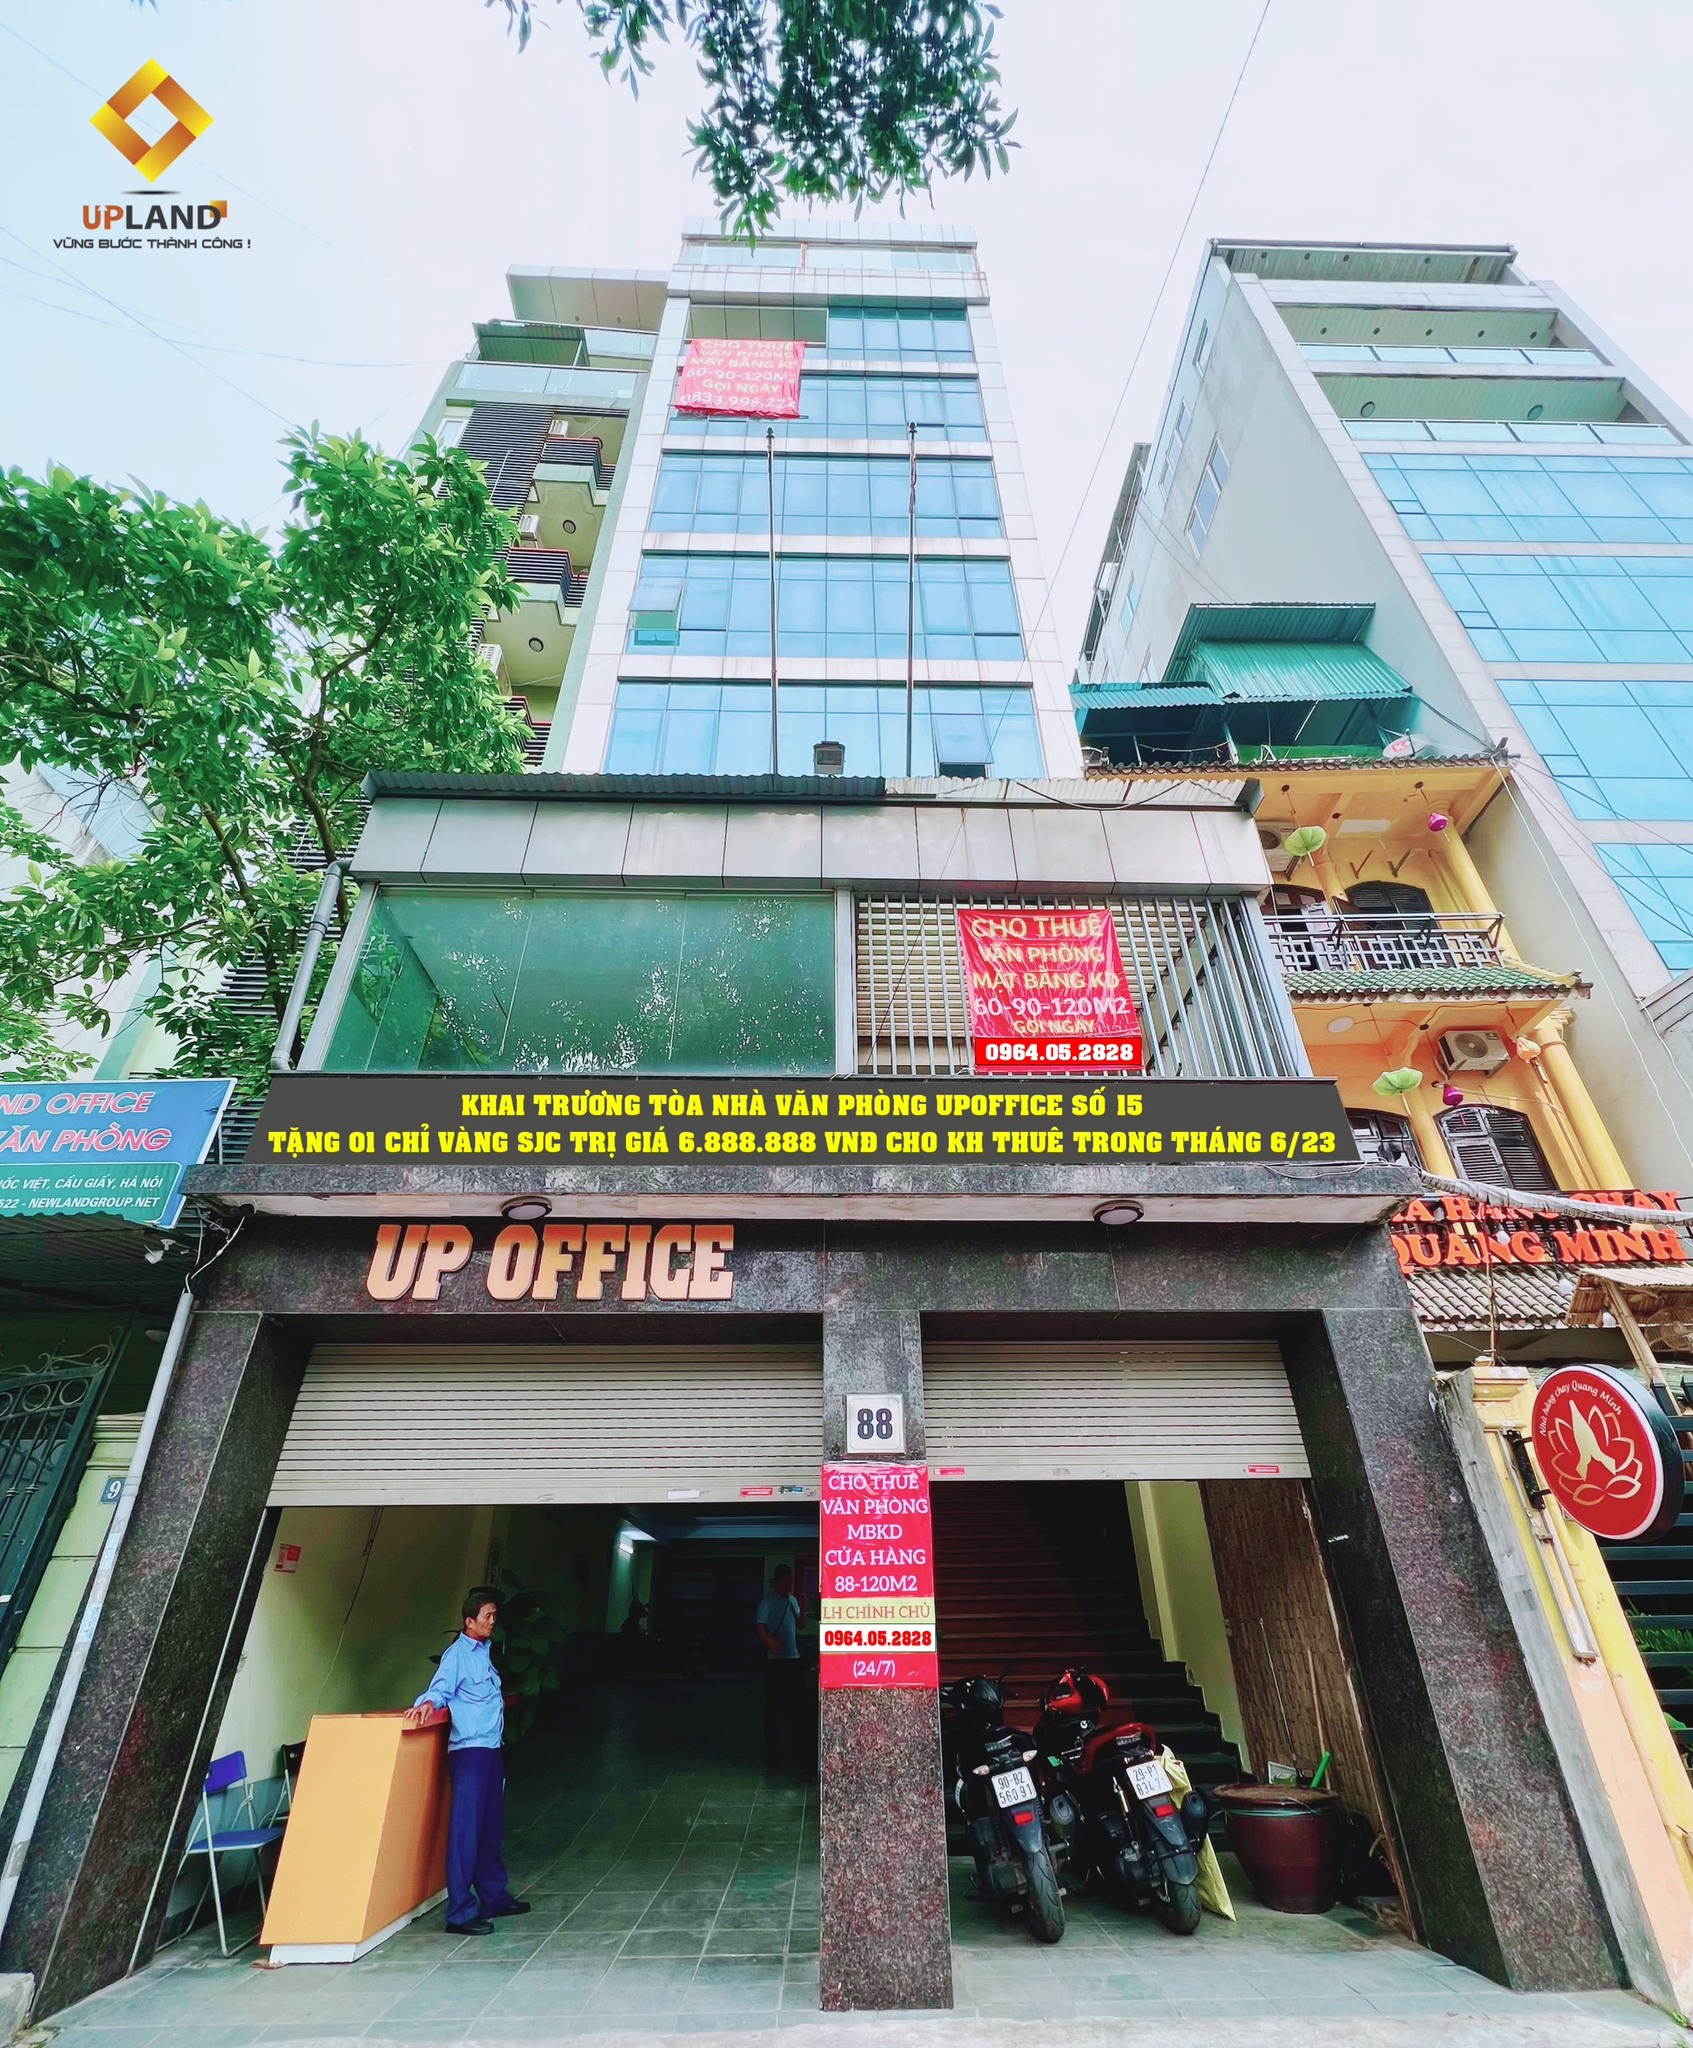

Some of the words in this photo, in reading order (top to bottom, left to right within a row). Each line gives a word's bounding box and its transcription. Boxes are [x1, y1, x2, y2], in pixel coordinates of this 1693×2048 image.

[701, 340, 741, 349] CHO
[736, 382, 781, 394] NGAY
[971, 917, 1028, 938] CHO
[1032, 912, 1104, 938] THUÊ
[979, 942, 1024, 963] VĂN
[1027, 942, 1105, 963] PHÒNG
[972, 969, 1018, 994] MẶT
[1023, 965, 1086, 989] BẰNG
[1090, 972, 1121, 989] KD
[973, 996, 1131, 1016] 60-90-120M2
[1013, 1019, 1046, 1036] GỌI
[1049, 1019, 1096, 1034] NGAY
[985, 1043, 1134, 1062] 0964.05.2828
[46, 1091, 156, 1114] OFFICE
[462, 1094, 525, 1116] KHAI
[533, 1089, 641, 1116] TRƯƠNG
[649, 1089, 703, 1116] TÒA
[712, 1089, 767, 1116] NHÀ
[775, 1089, 829, 1116] VĂN
[838, 1089, 927, 1116] PHÒNG
[936, 1094, 1063, 1116] UPOFFICE
[1071, 1086, 1107, 1116] SỐ
[1117, 1094, 1143, 1116] 15
[0, 1124, 52, 1153] ĂN
[51, 1121, 173, 1152] PHÒNG
[268, 1127, 340, 1158] TẶNG
[385, 1122, 431, 1153] CHỈ
[438, 1126, 509, 1153] VÀNG
[517, 1131, 561, 1153] SJC
[570, 1131, 617, 1159] TRỊ
[625, 1126, 669, 1153] GIÁ
[678, 1131, 817, 1153] 6.888.888
[825, 1131, 878, 1153] VNĐ
[886, 1131, 938, 1153] CHO
[947, 1131, 984, 1153] KH
[992, 1126, 1064, 1153] THUÊ
[1073, 1131, 1163, 1153] TRONG
[1171, 1125, 1262, 1153] THÁNG
[1270, 1131, 1336, 1158] 6/23
[0, 1174, 20, 1190] ỐC
[28, 1196, 161, 1209] NEWLANDGROUP.NET
[1551, 1228, 1689, 1264] MINH
[366, 1223, 474, 1301] UP
[485, 1223, 735, 1301] OFFICE
[1571, 1380, 1599, 1397] Quang
[857, 1408, 893, 1440] 88
[828, 1475, 868, 1491] CHO
[872, 1472, 920, 1490] THUÊ
[821, 1497, 860, 1515] VĂN
[864, 1496, 929, 1515] PHÒNG
[847, 1524, 903, 1540] MBKD
[825, 1546, 866, 1566] CỬA
[870, 1546, 926, 1566] HÀNG
[834, 1575, 918, 1593] 88-120M2
[823, 1606, 842, 1620] LH
[845, 1603, 895, 1619] CHÍNH
[898, 1602, 931, 1618] CHỦ
[824, 1630, 932, 1647] 0964.05.2828
[853, 1659, 896, 1679] (24/7)
[997, 1771, 1026, 1790] 90-B2
[1132, 1764, 1159, 1782] 29-P1
